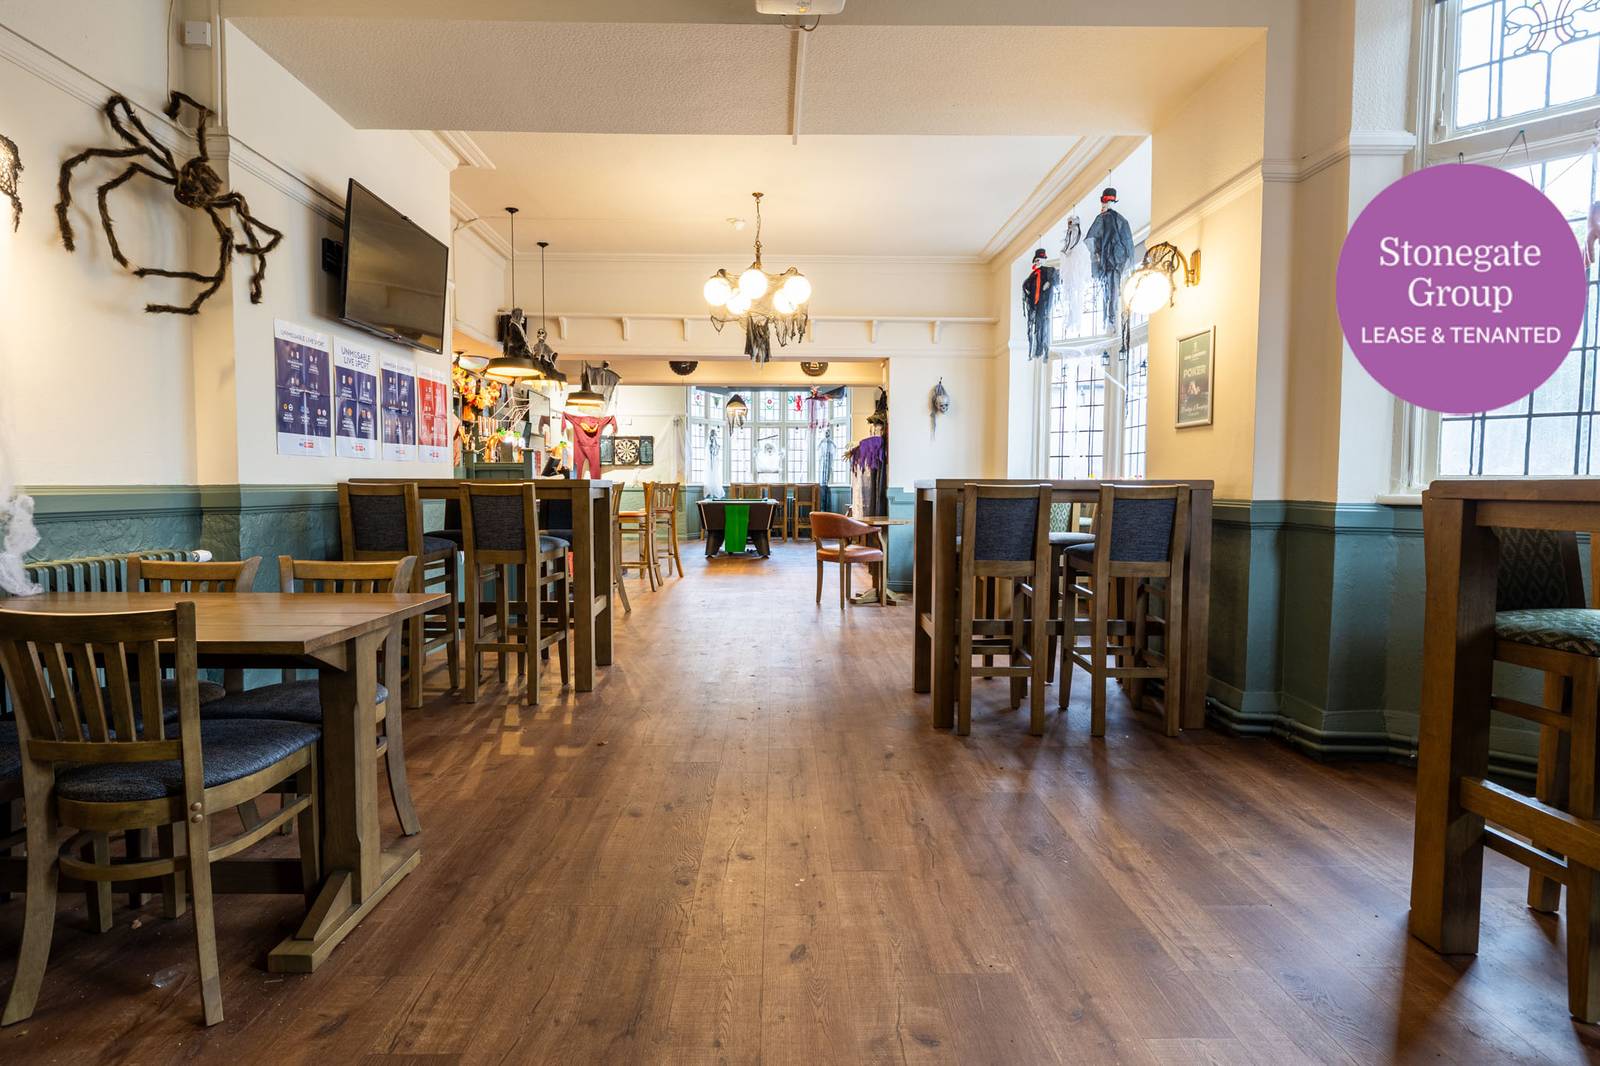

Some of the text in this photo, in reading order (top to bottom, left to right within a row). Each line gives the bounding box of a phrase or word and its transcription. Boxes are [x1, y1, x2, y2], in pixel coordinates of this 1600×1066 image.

[341, 347, 371, 362] UNMISSABLE
[343, 355, 369, 369] LIVE SPORT
[1183, 366, 1206, 378] POKER
